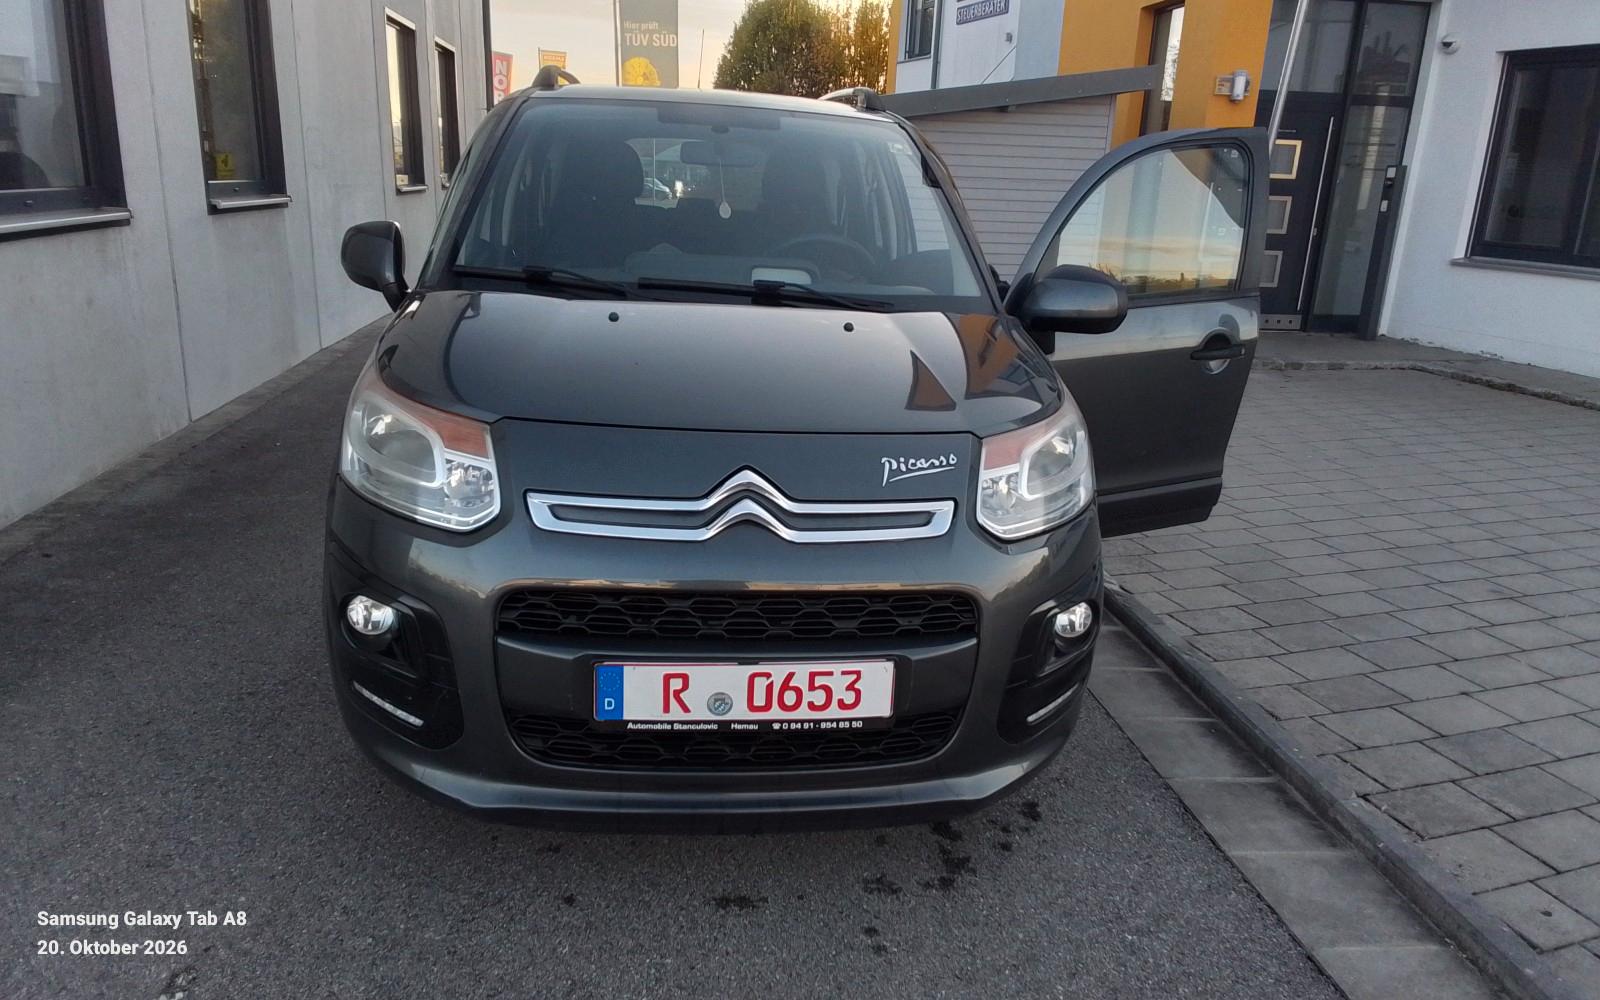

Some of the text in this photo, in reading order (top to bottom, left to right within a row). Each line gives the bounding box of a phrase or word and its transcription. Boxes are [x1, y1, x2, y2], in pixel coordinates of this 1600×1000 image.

[624, 30, 677, 47] TÜV SÜD
[662, 670, 863, 714] R 0653
[604, 698, 615, 711] D
[627, 722, 671, 730] Automobile
